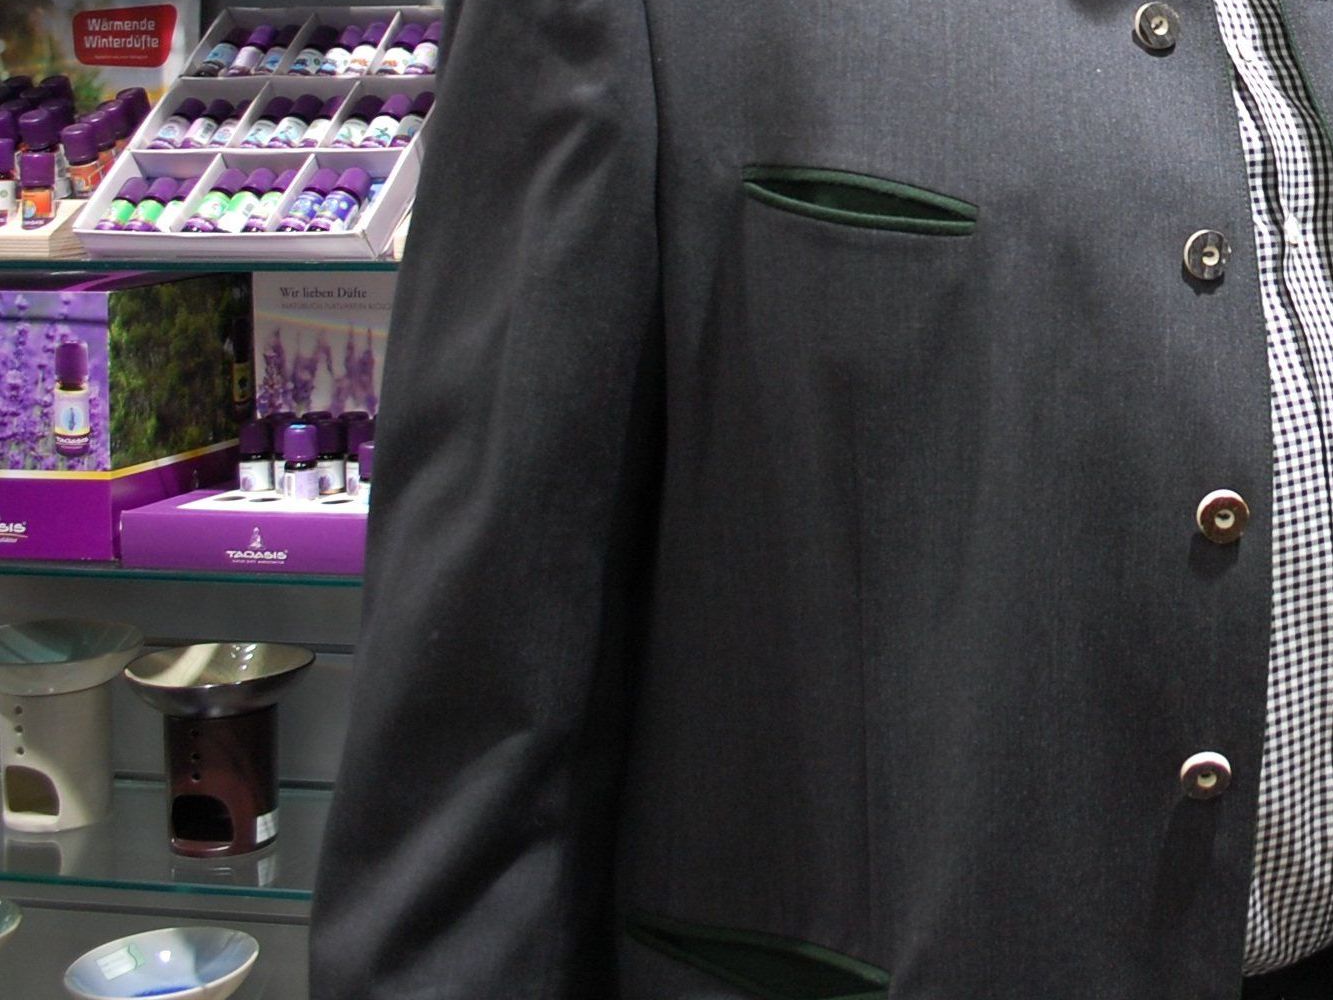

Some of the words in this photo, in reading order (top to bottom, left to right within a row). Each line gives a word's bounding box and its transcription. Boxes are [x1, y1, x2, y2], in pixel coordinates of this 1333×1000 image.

[87, 18, 155, 31] Wärmende
[84, 33, 159, 50] Winterdüfte
[280, 286, 300, 298] Wir
[303, 286, 334, 298] lieben
[337, 286, 368, 299] Düfte
[225, 550, 287, 560] TAOASIS
